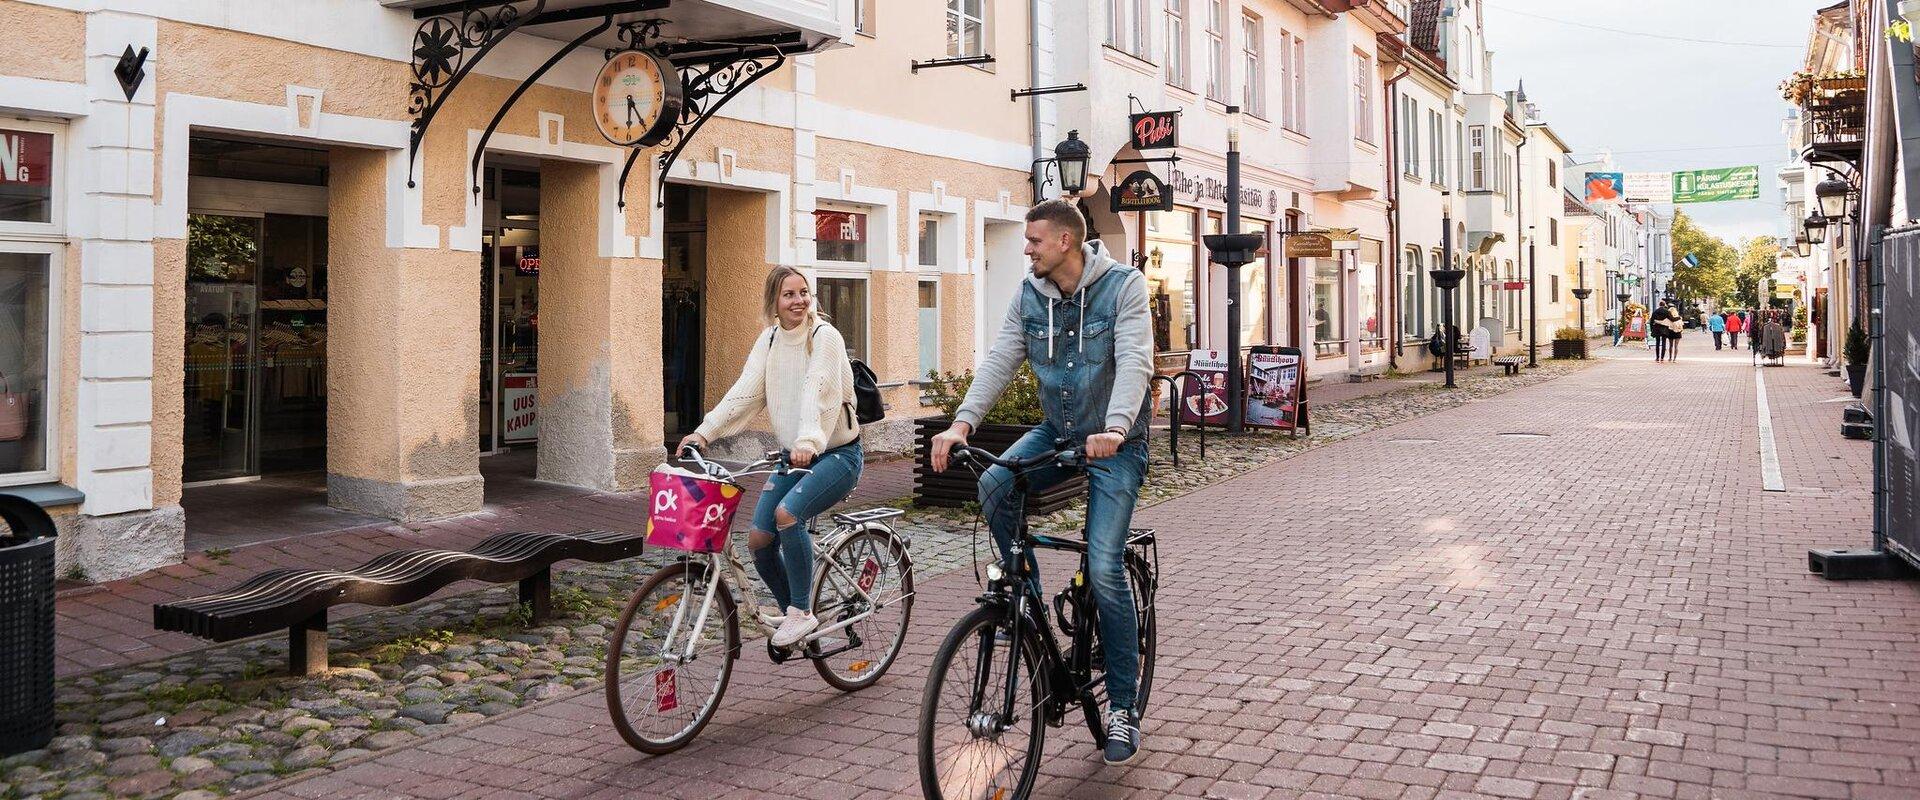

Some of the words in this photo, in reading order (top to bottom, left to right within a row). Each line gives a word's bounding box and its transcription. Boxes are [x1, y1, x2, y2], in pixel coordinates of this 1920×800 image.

[1135, 116, 1173, 147] Pubi
[1697, 174, 1721, 182] PÄRNU
[1194, 360, 1228, 369] Rüütlihoo
[513, 394, 535, 412] UUS
[507, 412, 536, 433] KAUP
[654, 488, 678, 514] pk
[702, 502, 727, 525] pk
